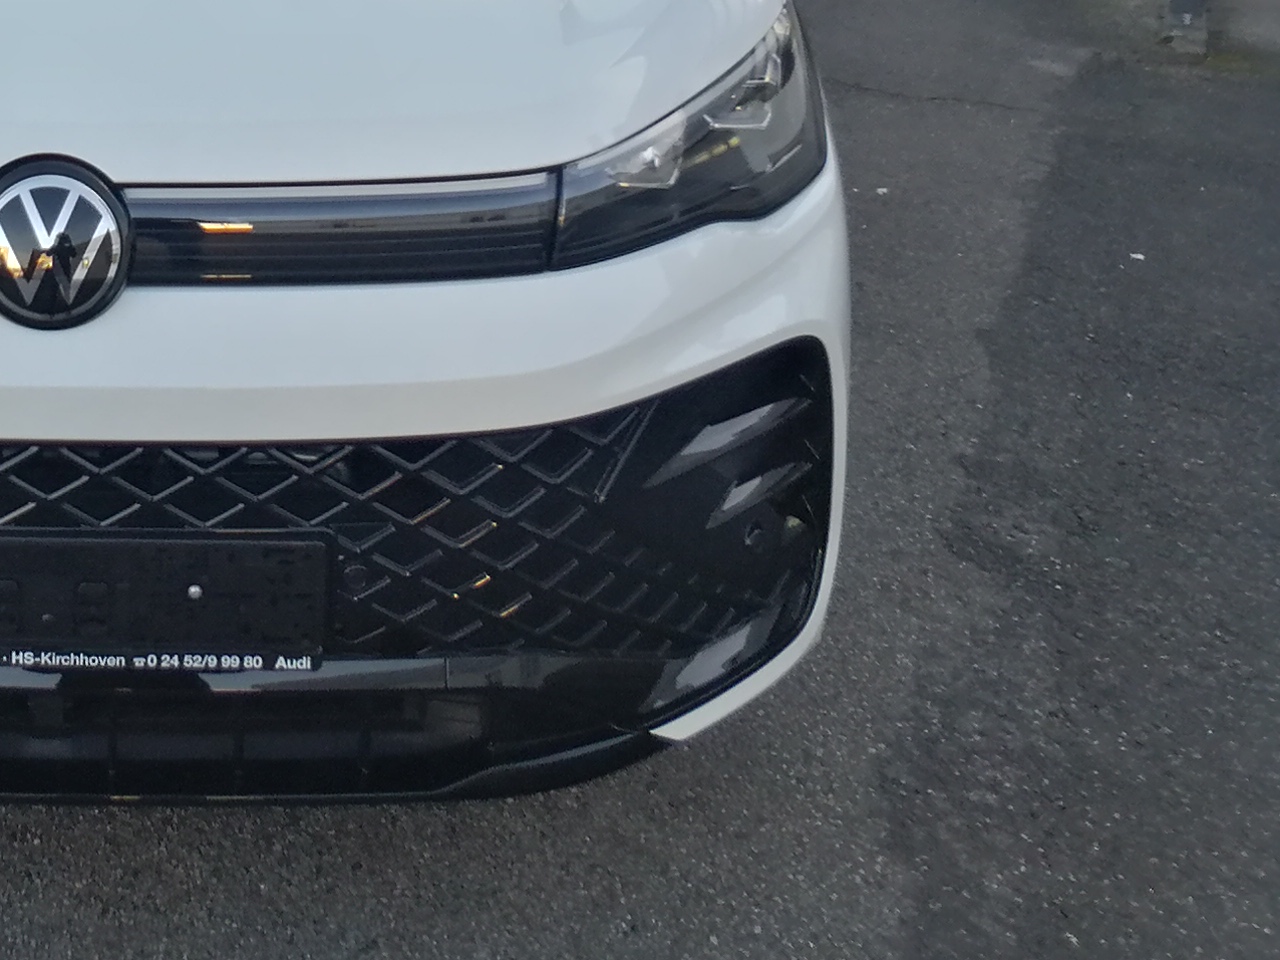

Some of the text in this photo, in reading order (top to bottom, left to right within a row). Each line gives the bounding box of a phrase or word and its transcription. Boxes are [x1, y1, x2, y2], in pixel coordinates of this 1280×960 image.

[11, 651, 125, 668] HS-Kirchhoven
[161, 655, 180, 667] 24
[183, 655, 217, 668] 52/9
[221, 656, 240, 668] 99
[243, 656, 263, 668] 80
[275, 655, 312, 670] Audi
